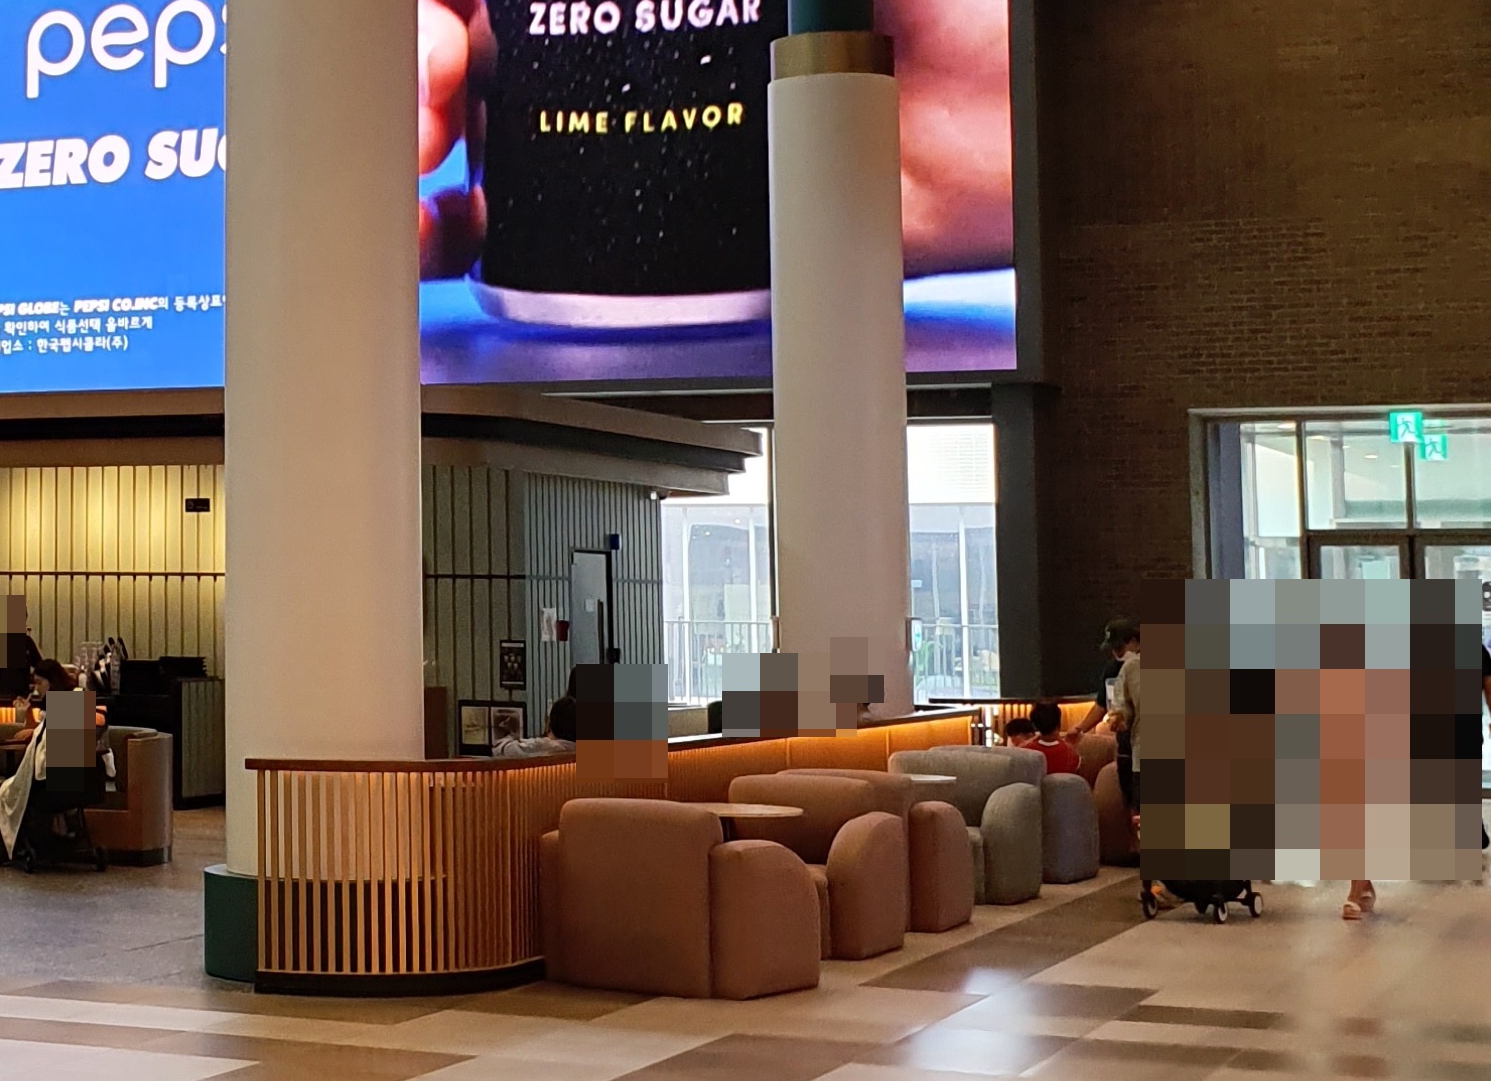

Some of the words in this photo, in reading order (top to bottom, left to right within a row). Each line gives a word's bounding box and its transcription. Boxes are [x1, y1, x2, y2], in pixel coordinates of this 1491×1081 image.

[529, 0, 622, 35] ZERO
[539, 110, 609, 134] LIME
[624, 102, 744, 134] FLAVOR
[73, 298, 110, 313] PEPSI
